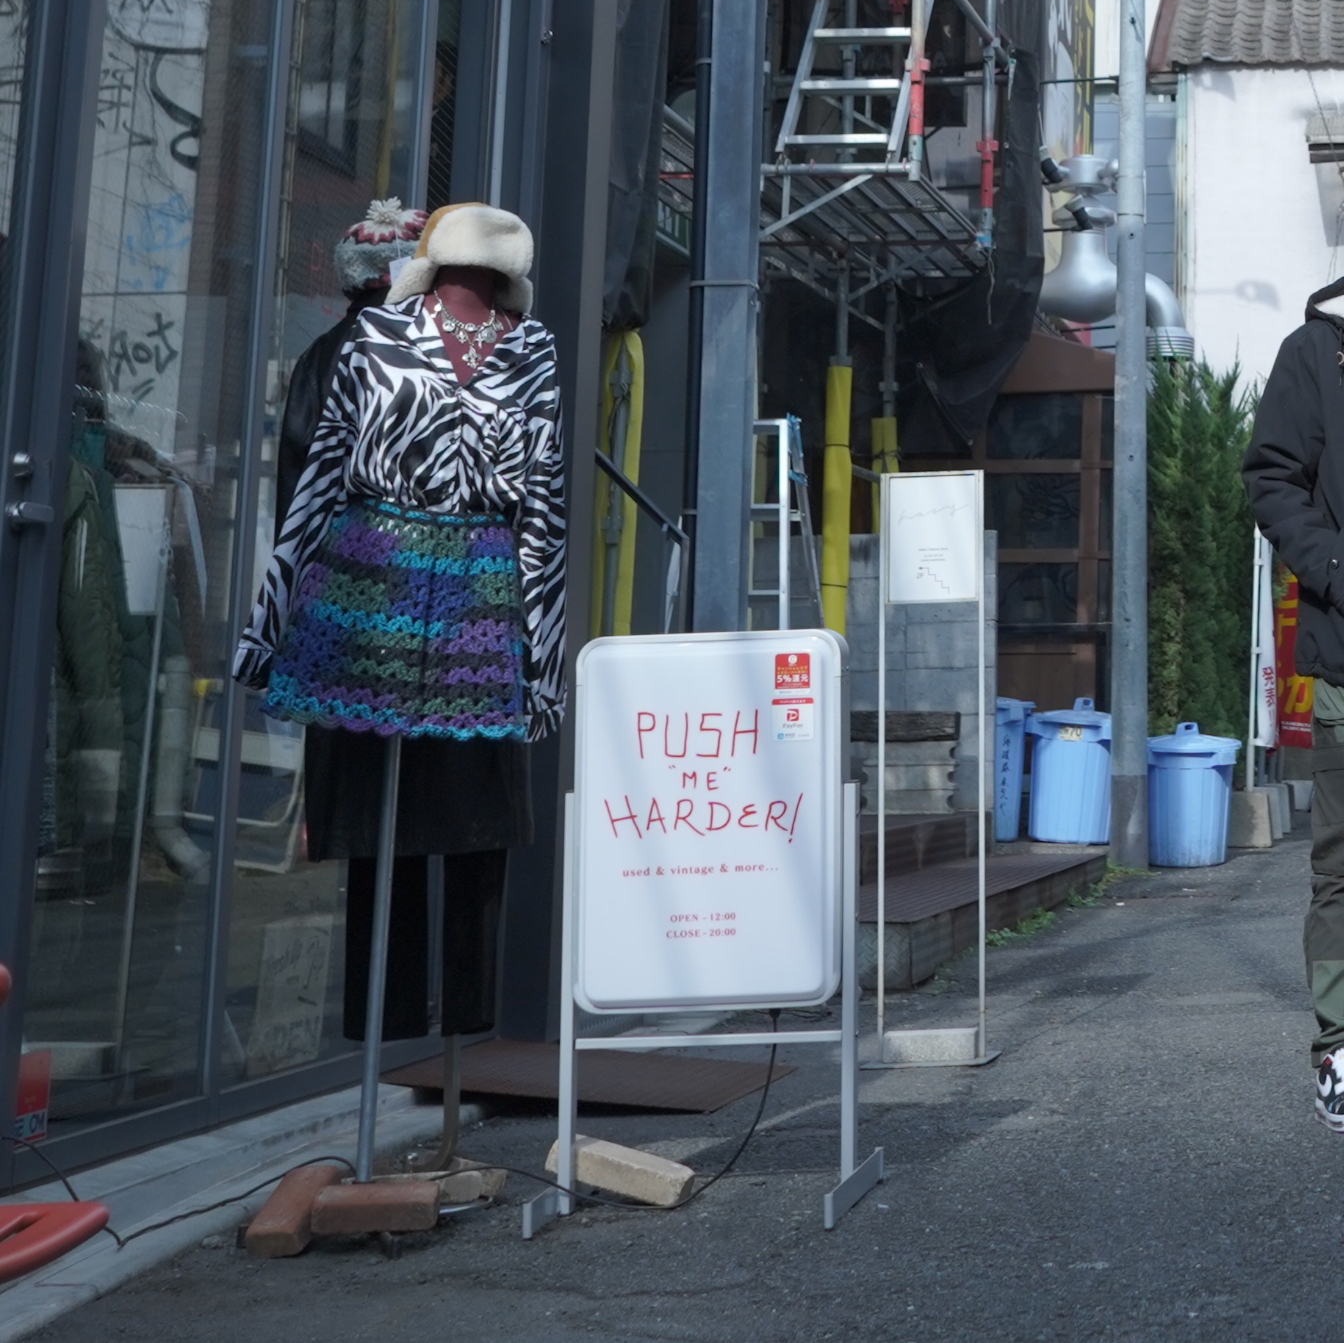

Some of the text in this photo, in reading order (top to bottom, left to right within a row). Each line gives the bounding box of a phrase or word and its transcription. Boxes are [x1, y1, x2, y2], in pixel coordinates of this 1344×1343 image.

[636, 709, 759, 759] PUSH
[603, 792, 804, 844] HARDER!
[622, 863, 779, 877] used & vintage & more...
[670, 913, 699, 923] OPEN
[709, 912, 736, 921] 12:00
[666, 929, 701, 939] CLOSE
[709, 927, 736, 937] 20:00
